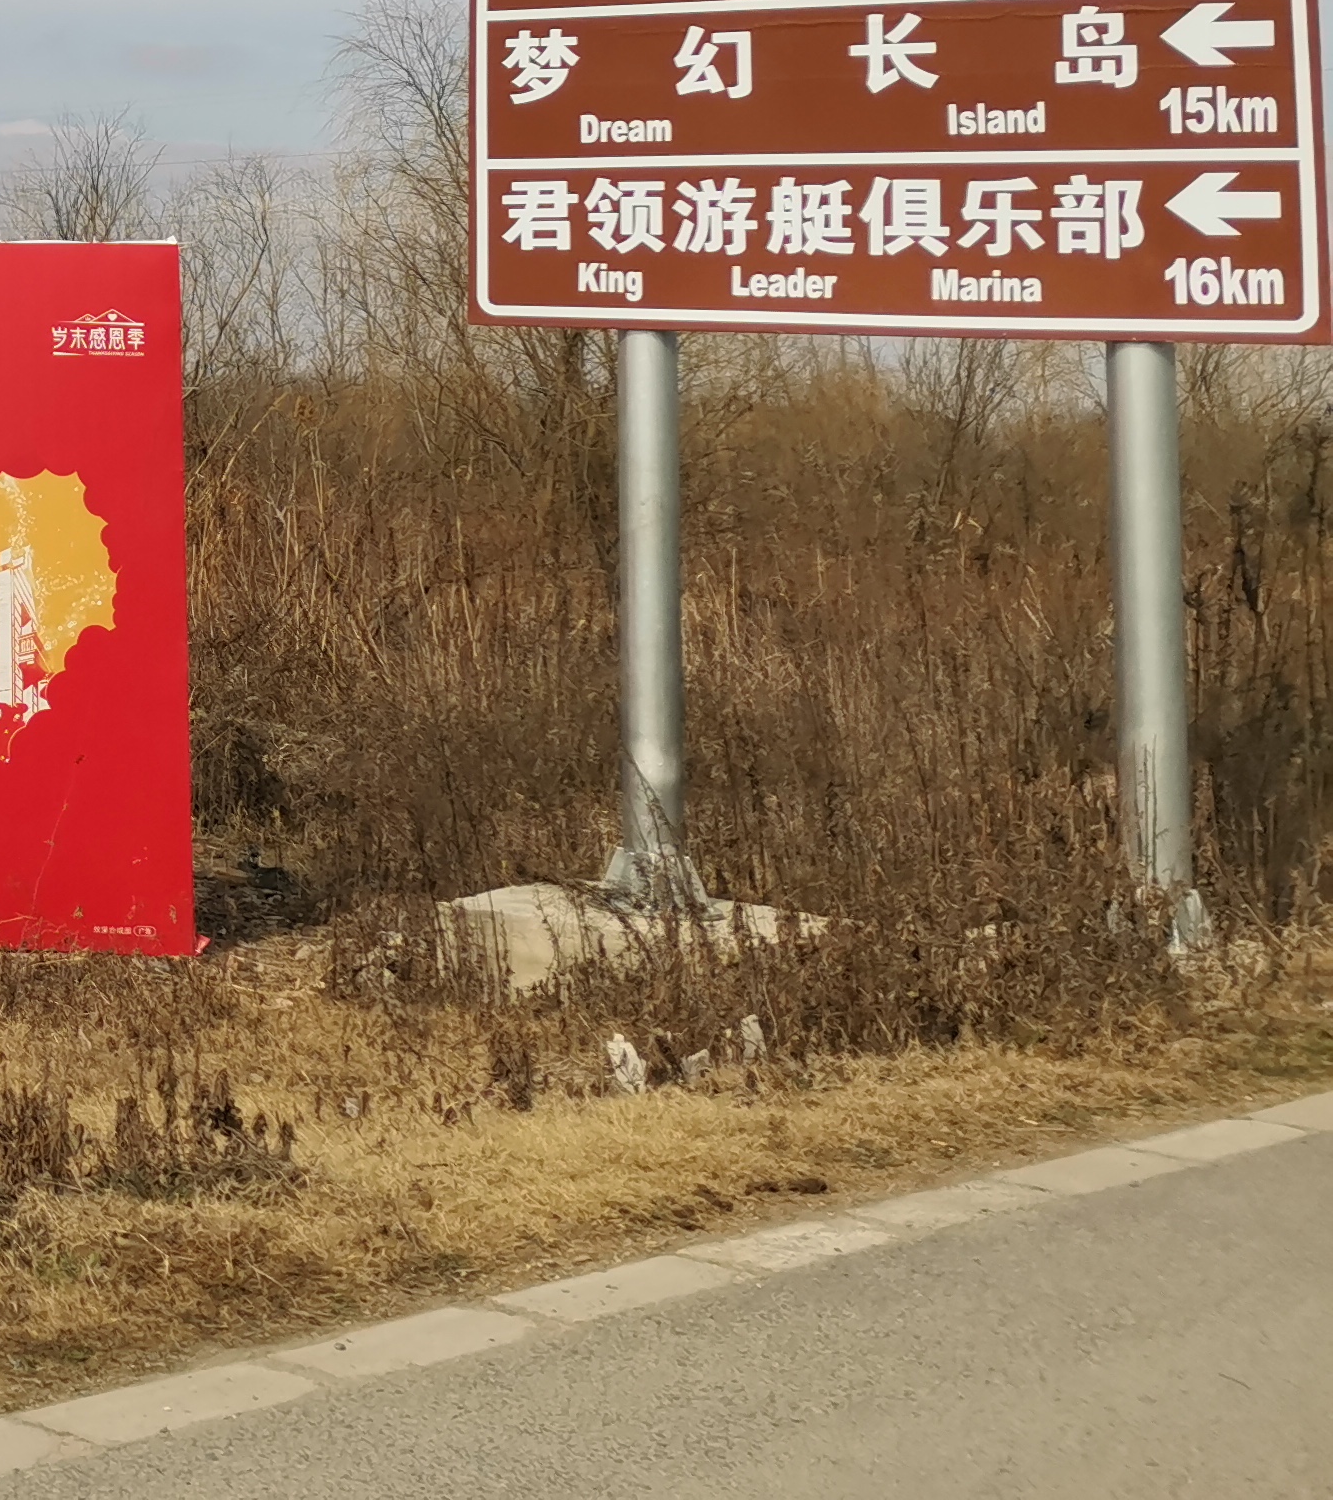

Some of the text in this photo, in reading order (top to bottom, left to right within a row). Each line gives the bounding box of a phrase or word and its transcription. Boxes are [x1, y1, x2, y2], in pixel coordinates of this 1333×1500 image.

[502, 5, 1138, 104] 梦幻长岛
[579, 101, 1046, 144] Dream Island
[1159, 85, 1278, 134] 15km
[502, 175, 1145, 259] 君领游艇俱乐部
[577, 262, 1043, 303] King Leader Marina
[1164, 256, 1285, 306] 16km
[52, 327, 145, 350] 岁末感恩季
